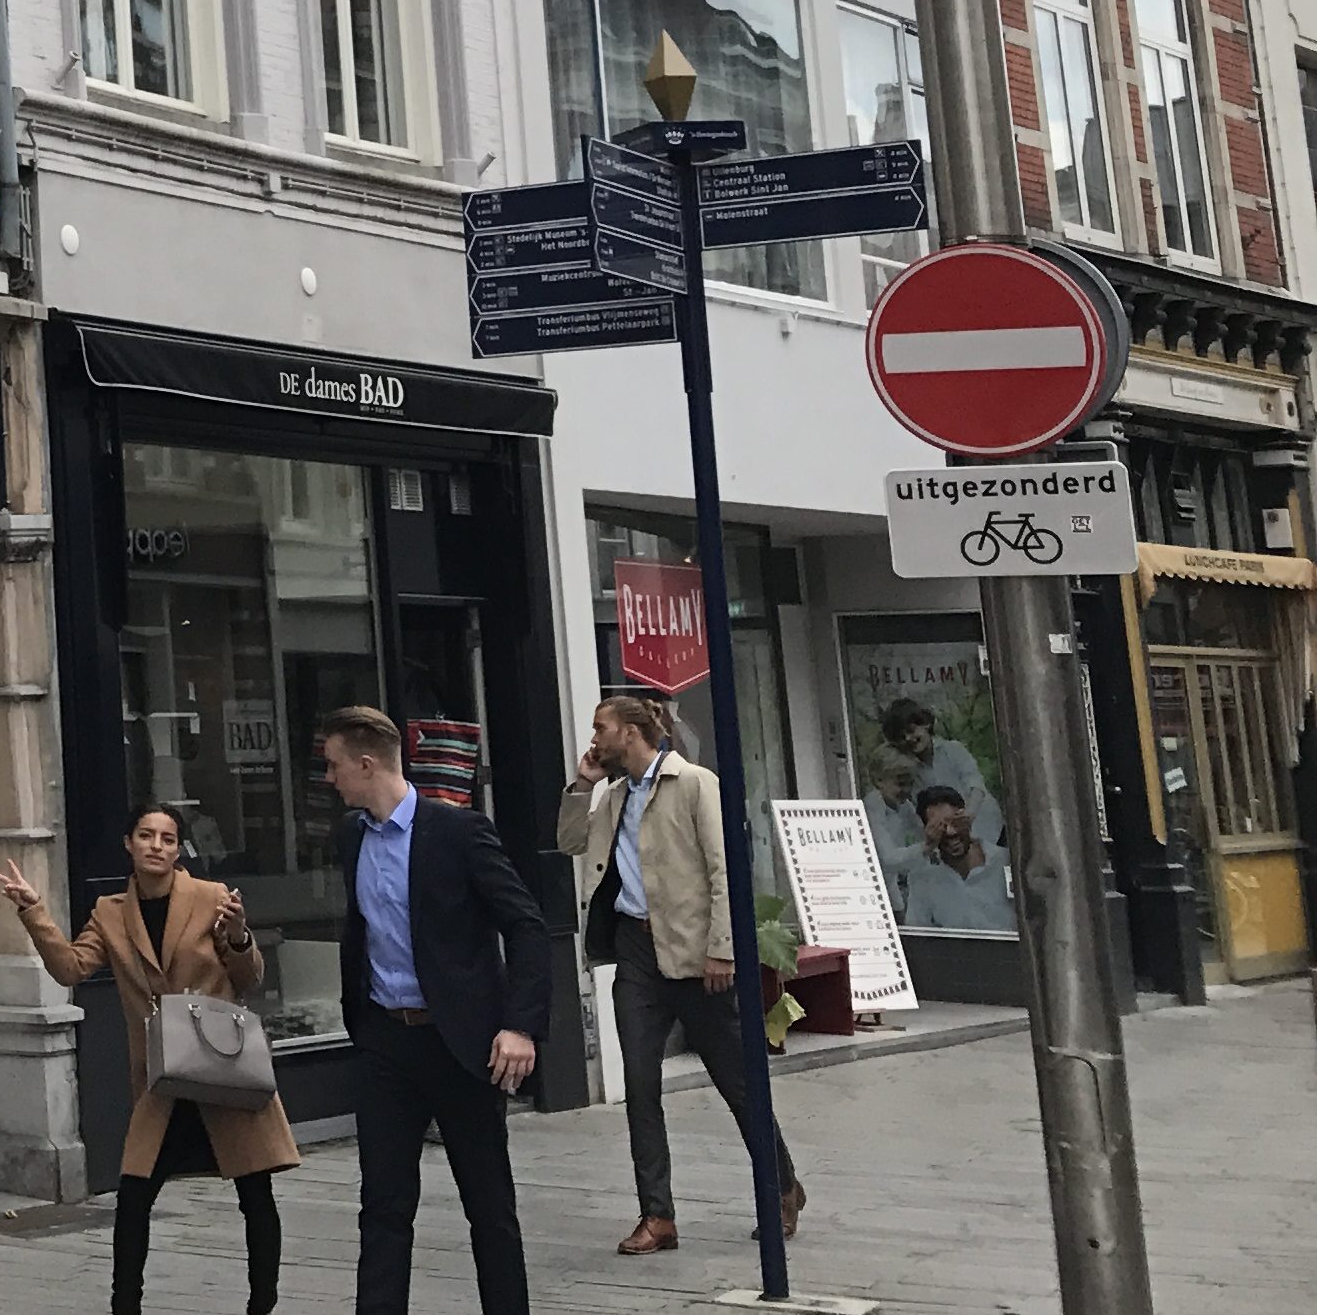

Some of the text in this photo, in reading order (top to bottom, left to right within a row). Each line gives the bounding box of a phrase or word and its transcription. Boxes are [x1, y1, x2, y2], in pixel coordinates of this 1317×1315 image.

[713, 172, 786, 187] Centraal Station
[714, 183, 789, 199] Bolwerk Sint Jan
[716, 207, 768, 220] Molenstraat
[507, 232, 543, 244] Stedelijk
[545, 229, 577, 240] Museum
[541, 241, 556, 251] Het
[537, 313, 600, 326] Transferiumbus
[537, 318, 660, 336] Transferiumbus Pettelaarpark
[280, 367, 404, 408] DE dames BAD
[896, 470, 1116, 505] uitgezonderd
[623, 584, 702, 645] BELLAMY
[869, 661, 968, 692] BELLAMY
[797, 827, 853, 846] BELLAMY
